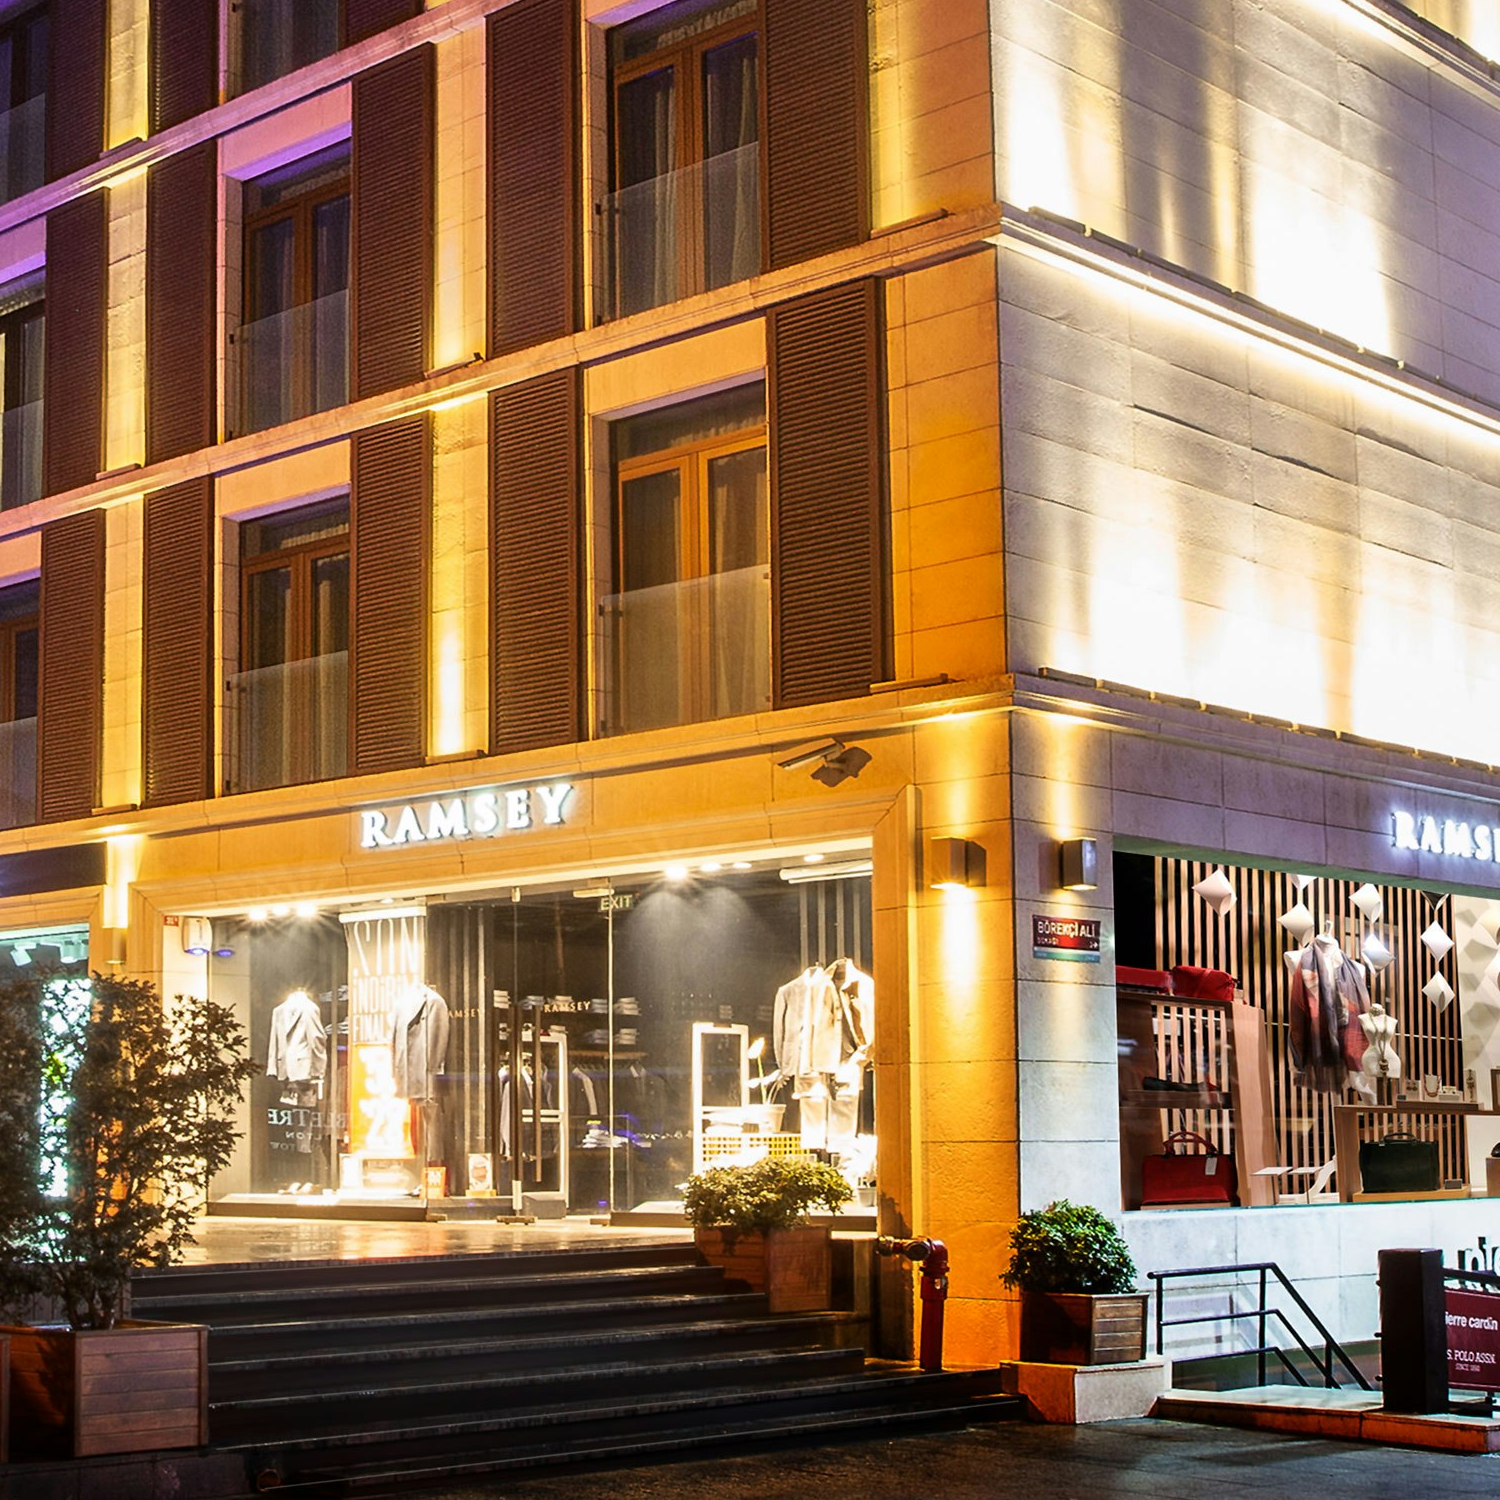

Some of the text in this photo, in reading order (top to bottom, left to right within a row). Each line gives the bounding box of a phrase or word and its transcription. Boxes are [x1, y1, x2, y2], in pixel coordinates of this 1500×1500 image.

[360, 783, 574, 848] RAMSEY
[600, 894, 633, 911] EXIT
[544, 1001, 591, 1013] RAMSEY
[1445, 1311, 1498, 1331] ierre cardin
[1454, 1349, 1474, 1363] POLO
